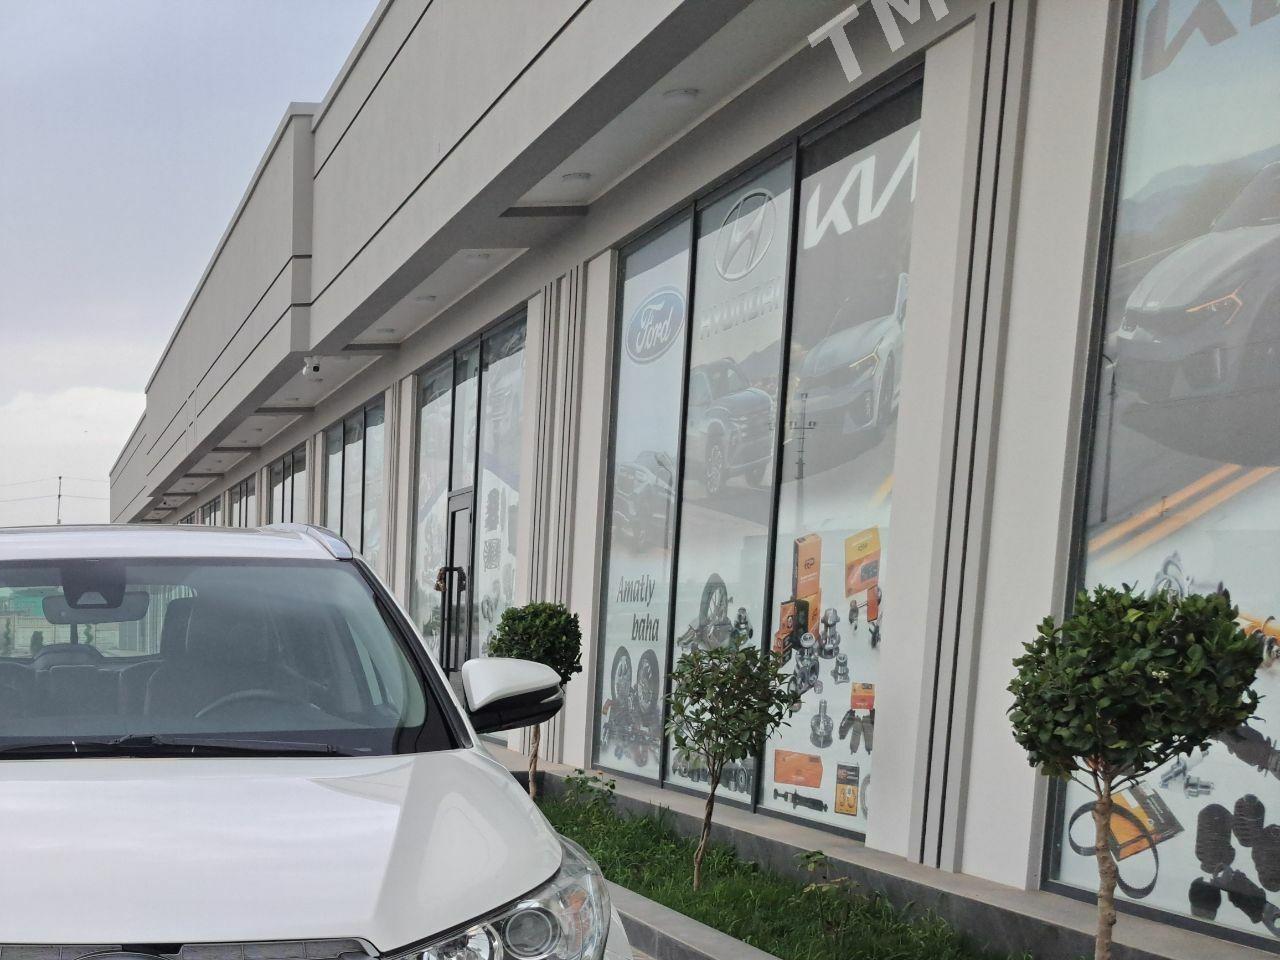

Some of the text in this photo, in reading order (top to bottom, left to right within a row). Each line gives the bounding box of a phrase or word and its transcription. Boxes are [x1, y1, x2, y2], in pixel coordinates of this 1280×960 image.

[635, 300, 674, 353] Ford
[616, 574, 655, 607] Amatly
[631, 613, 660, 641] baha
